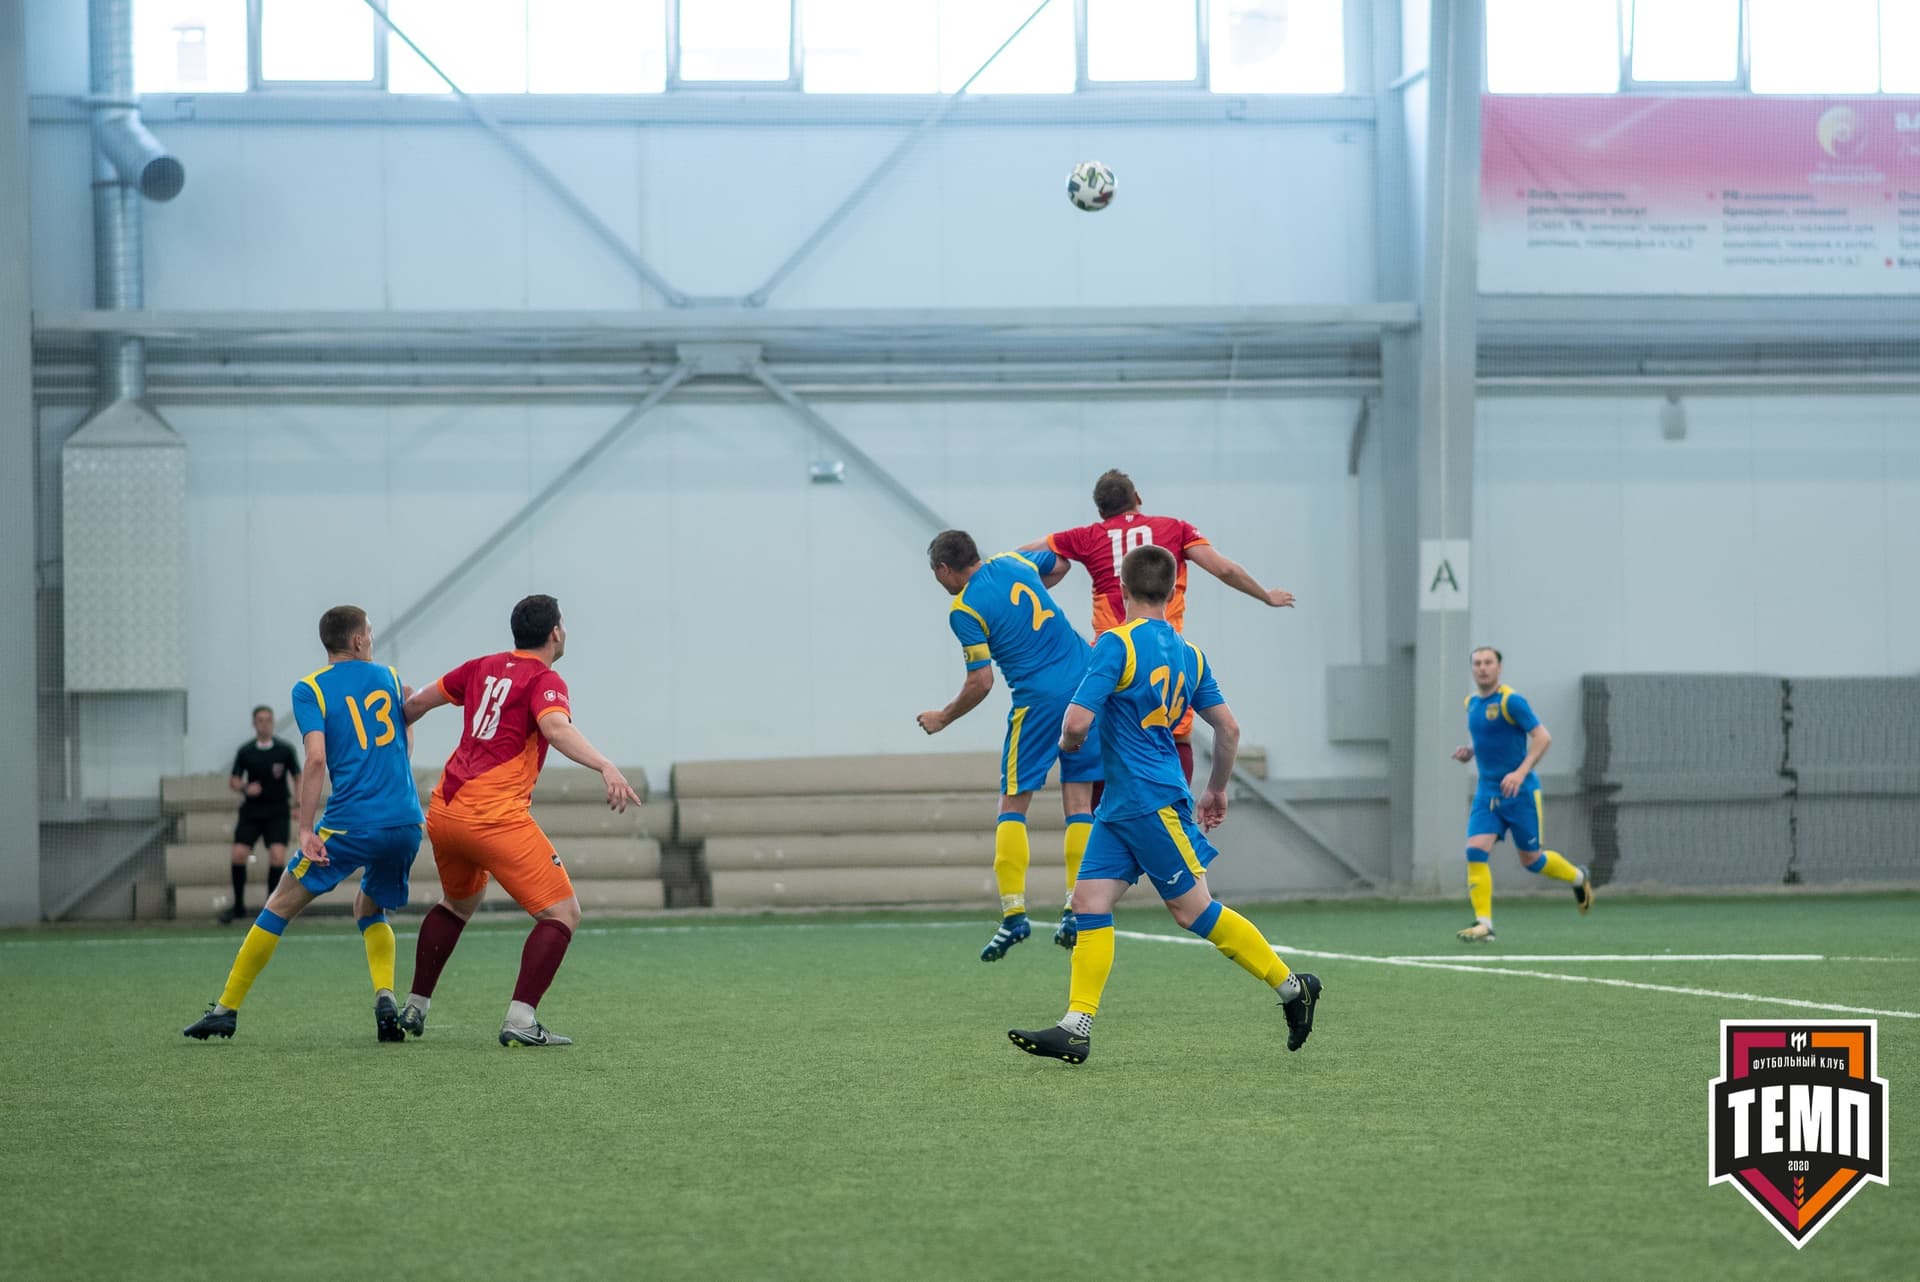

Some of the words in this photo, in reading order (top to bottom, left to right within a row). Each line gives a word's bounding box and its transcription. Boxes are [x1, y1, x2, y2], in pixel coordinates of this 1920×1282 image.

[1430, 559, 1459, 592] A
[1010, 582, 1055, 631] 2
[345, 690, 396, 750] 13
[471, 675, 513, 740] 13
